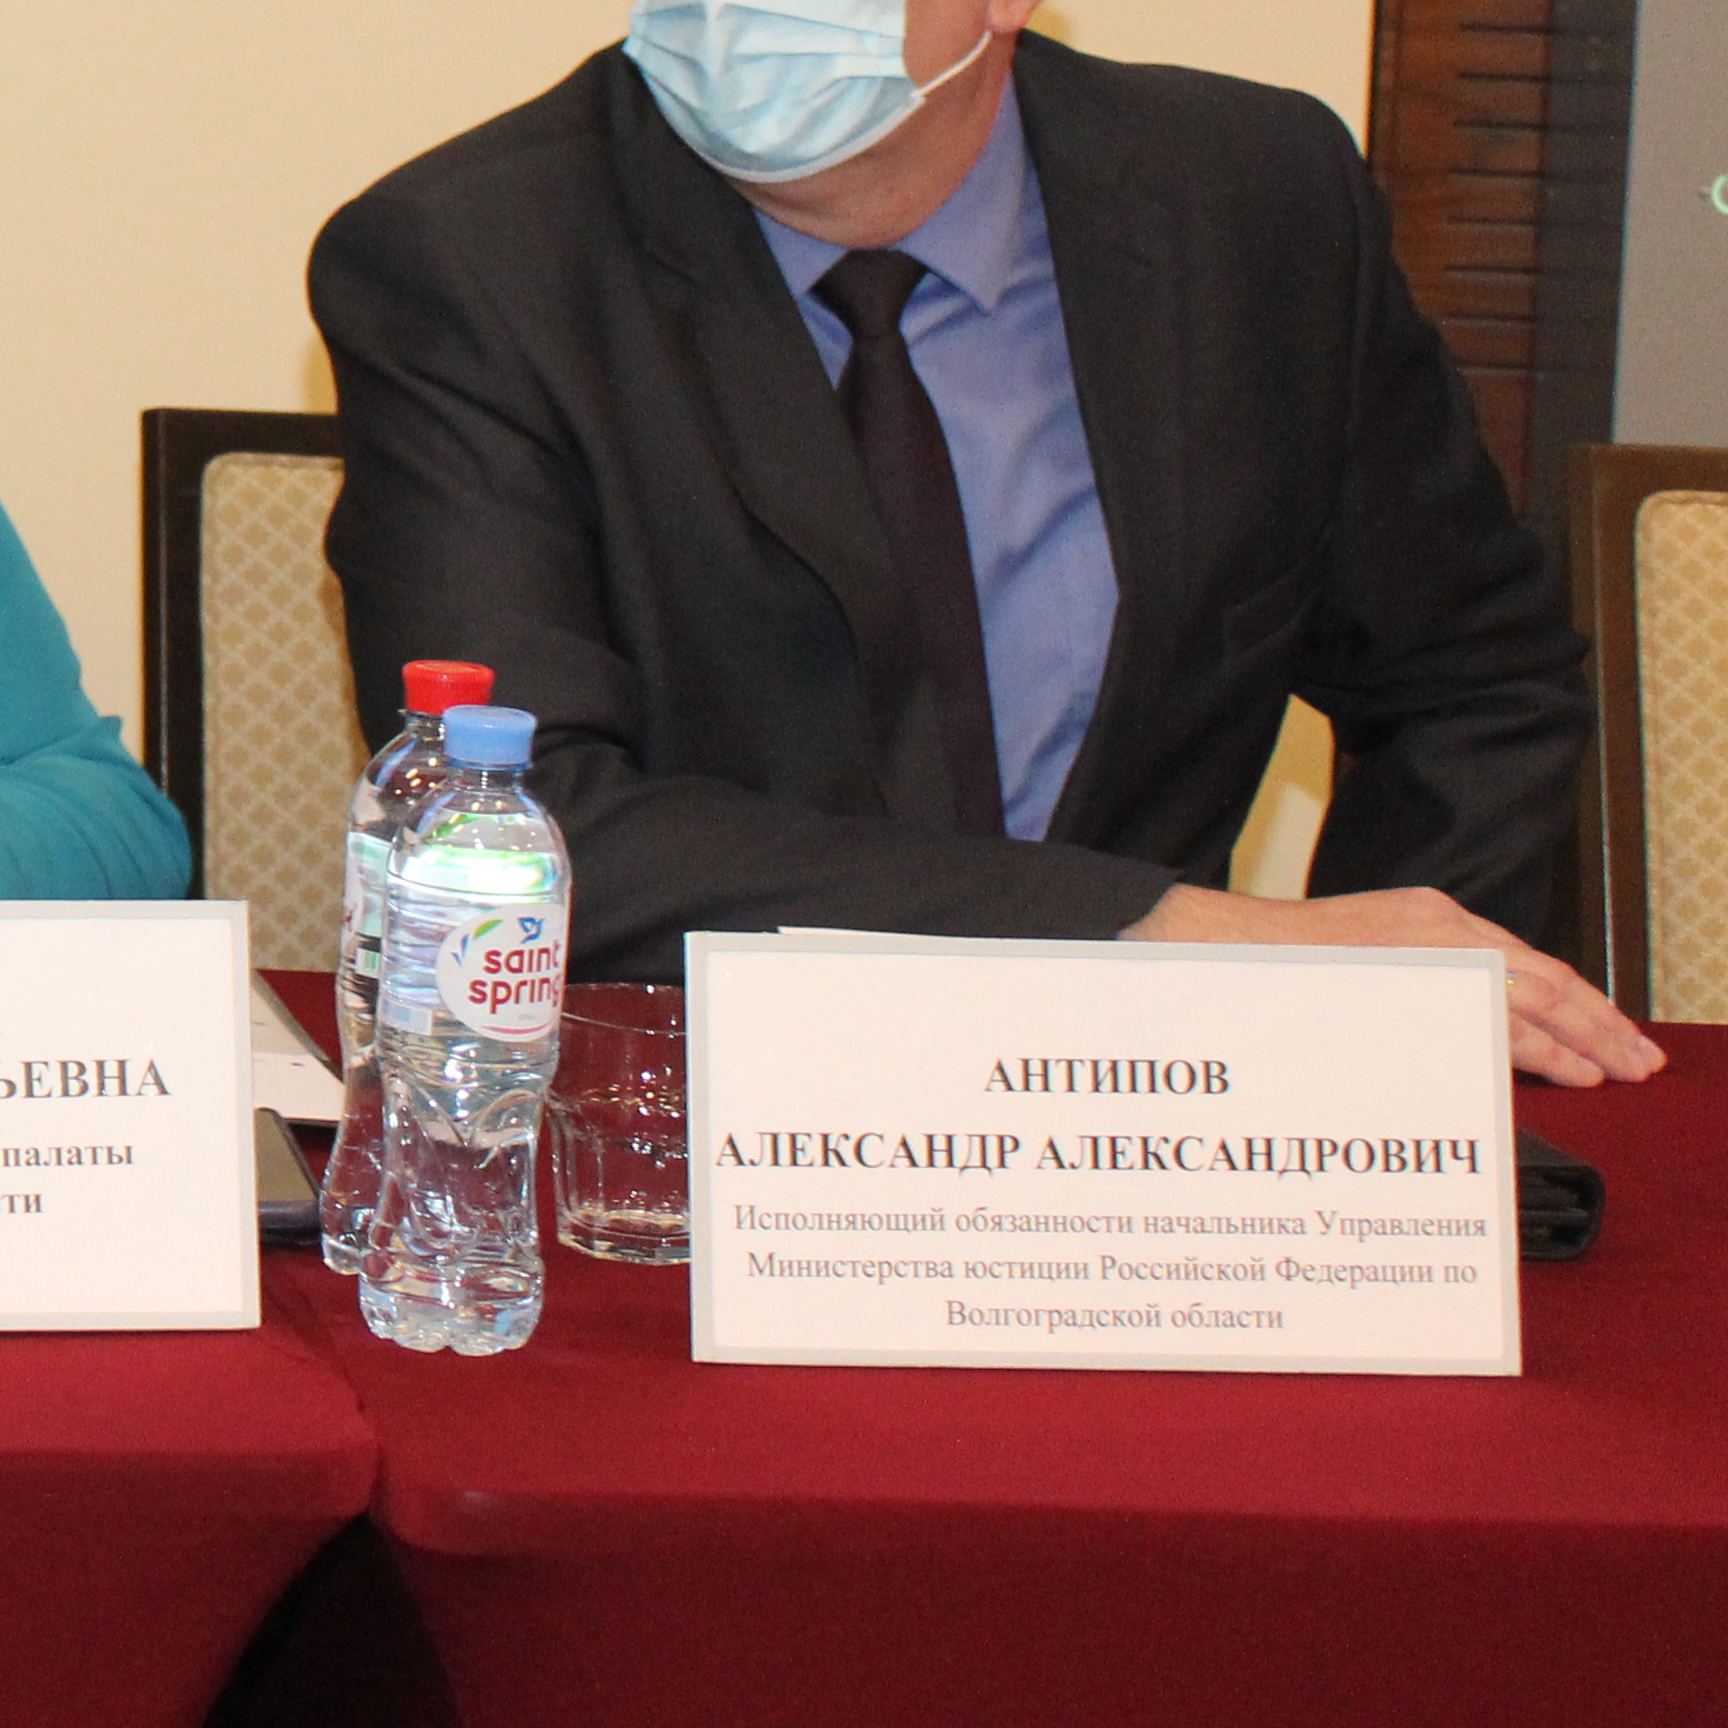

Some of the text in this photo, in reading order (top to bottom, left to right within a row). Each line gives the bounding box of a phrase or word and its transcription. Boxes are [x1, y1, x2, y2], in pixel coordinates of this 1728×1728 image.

[482, 939, 562, 975] saint
[983, 1056, 1232, 1097] АНТИПОВ
[1, 1143, 135, 1169] палаты
[715, 1131, 1482, 1181] АЛЕКСАНДР АЛЕКСАНДРОВИЧ
[734, 1203, 1488, 1242] Исполняющий обязанности начальника Управления
[747, 1251, 1478, 1290] Министерства юстиции Российской Федерации по
[945, 1299, 1284, 1334] Волгоградской области
